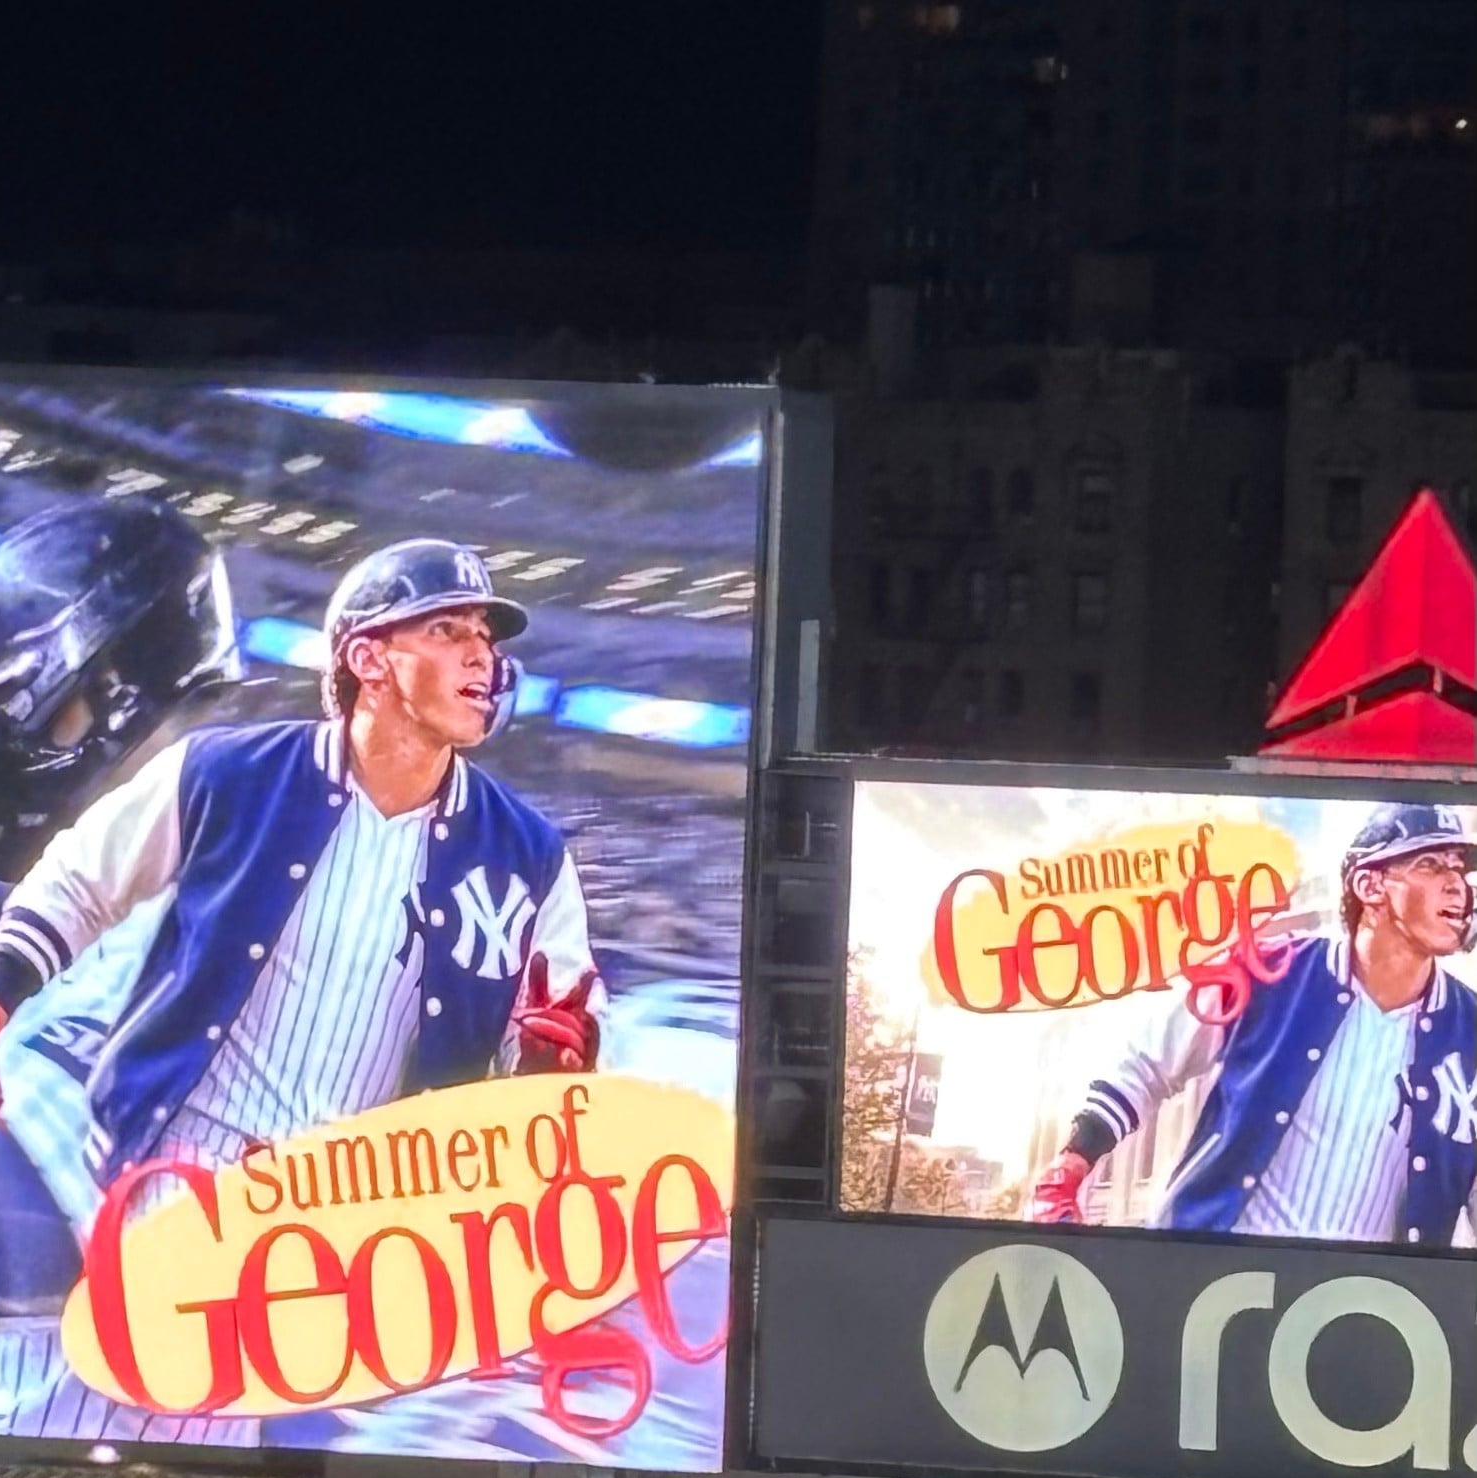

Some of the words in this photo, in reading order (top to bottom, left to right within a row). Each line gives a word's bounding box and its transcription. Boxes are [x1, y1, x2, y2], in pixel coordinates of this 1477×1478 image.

[451, 865, 536, 980] NY
[1020, 844, 1170, 899] Summer
[1178, 824, 1214, 879] of
[934, 864, 1294, 1025] George
[243, 1126, 515, 1214] Summer
[525, 1084, 590, 1182] of
[86, 1155, 730, 1439] George
[1179, 1271, 1477, 1472] ra
